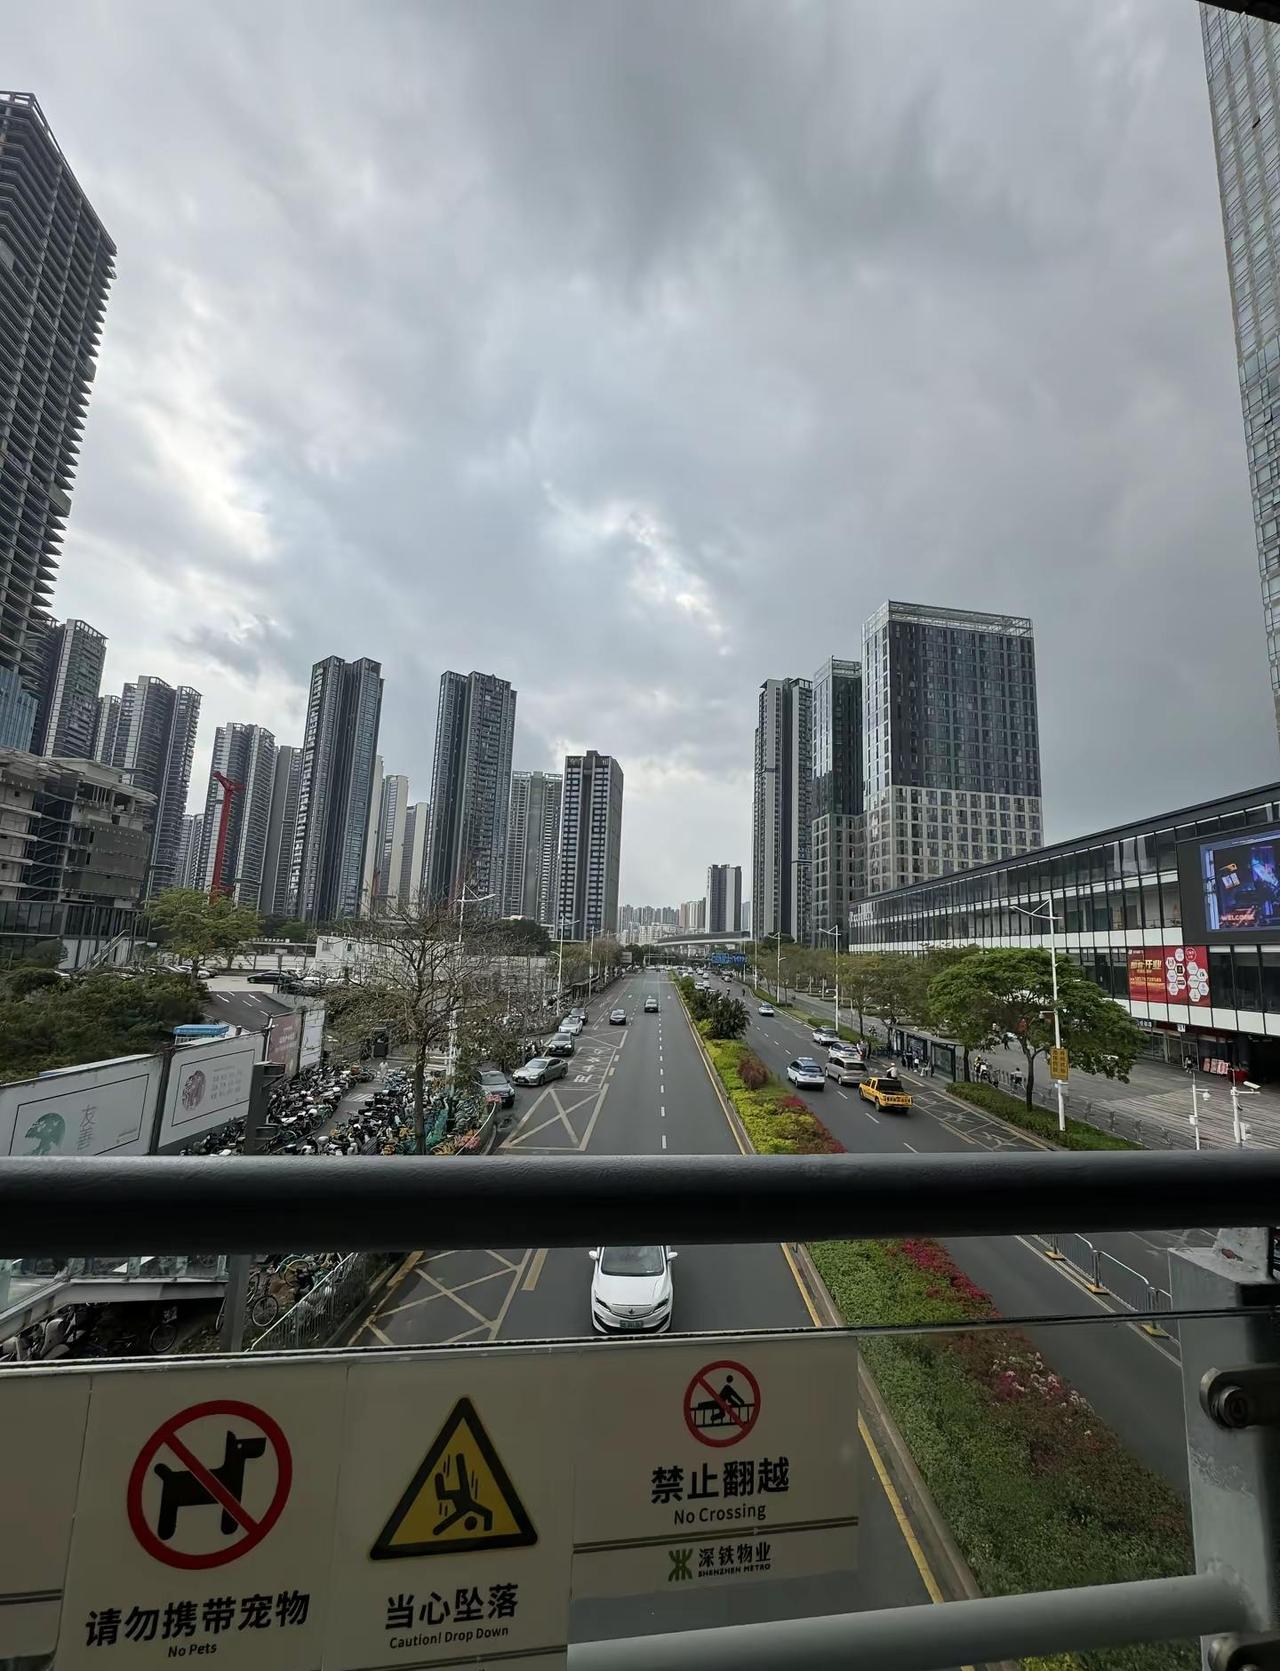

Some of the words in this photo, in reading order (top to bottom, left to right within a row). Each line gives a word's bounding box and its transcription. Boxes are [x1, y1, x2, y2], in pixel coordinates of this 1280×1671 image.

[651, 1456, 789, 1505] 禁止翻越
[674, 1509, 695, 1525] No
[699, 1503, 766, 1522] Crossing
[698, 1541, 771, 1568] 深铁物业
[698, 1567, 741, 1578] SHENZHEN
[743, 1563, 771, 1573] METRO
[385, 1583, 518, 1630] 当心坠落
[85, 1590, 310, 1648] 请勿携带宠物
[444, 1629, 474, 1643] Drop
[476, 1626, 509, 1639] Down
[168, 1646, 186, 1658] No
[188, 1643, 217, 1656] Pets
